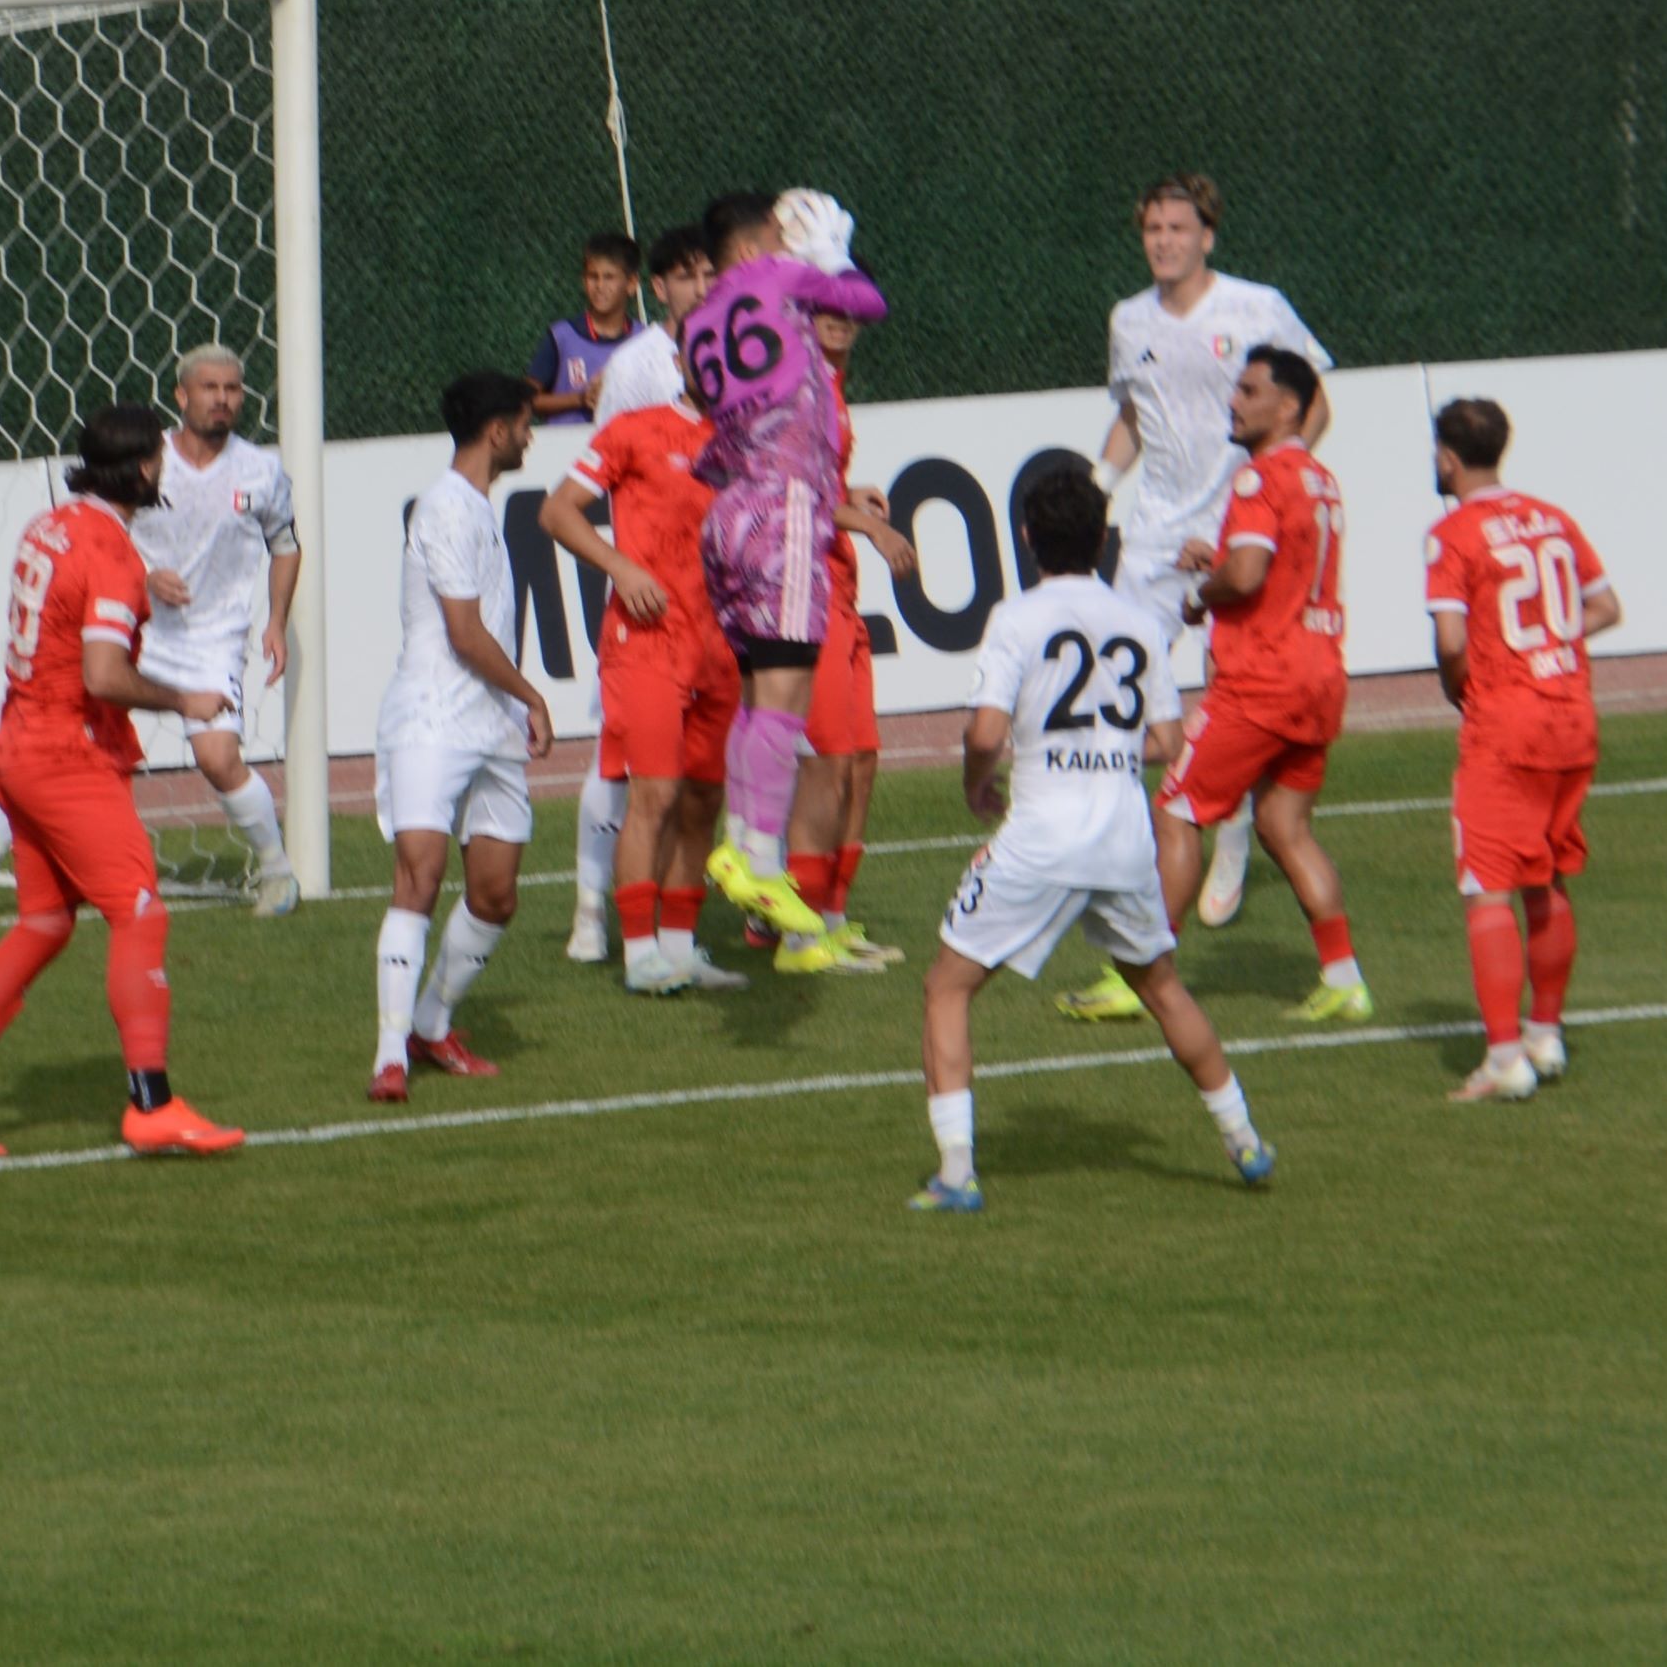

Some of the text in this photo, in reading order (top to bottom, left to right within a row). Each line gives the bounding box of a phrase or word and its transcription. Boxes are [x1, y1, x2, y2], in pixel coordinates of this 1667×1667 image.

[689, 295, 783, 406] 66
[1490, 536, 1584, 652] 20
[1042, 629, 1147, 732] 23
